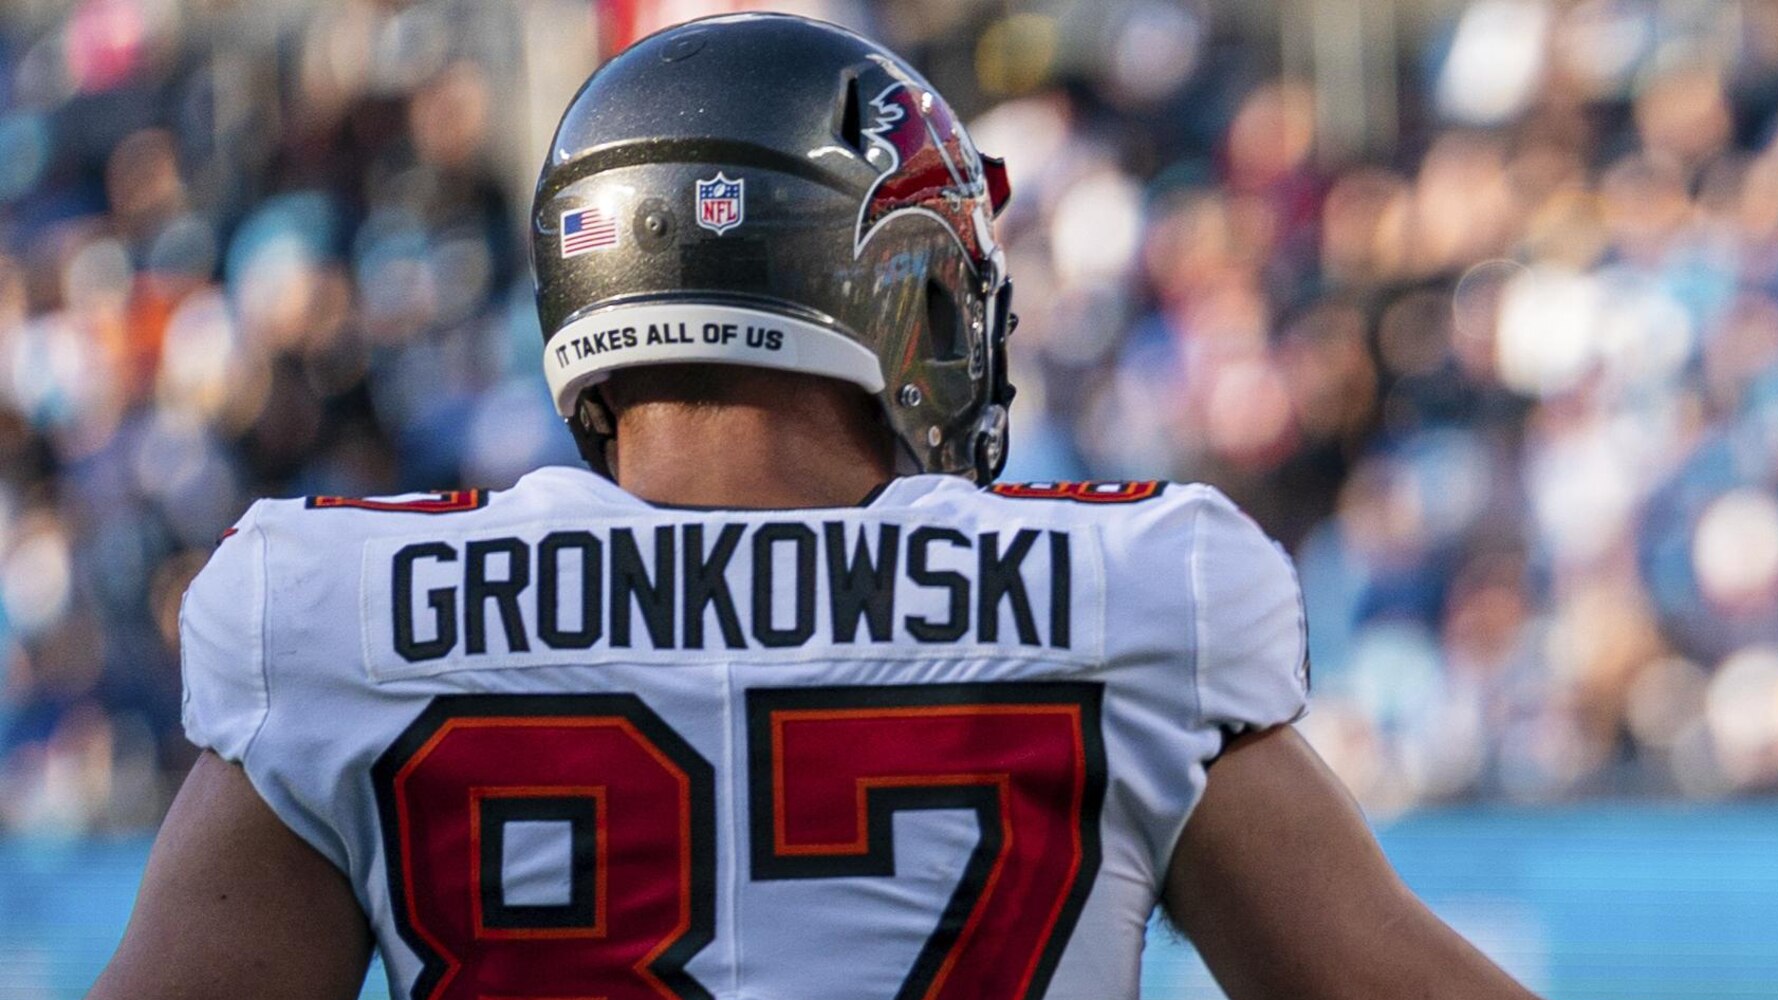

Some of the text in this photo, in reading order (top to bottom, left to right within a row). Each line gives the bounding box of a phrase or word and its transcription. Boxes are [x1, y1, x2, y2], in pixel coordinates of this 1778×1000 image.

[703, 200, 737, 224] NFL
[555, 322, 784, 369] IT TAKES ALL OF US
[391, 520, 1071, 662] GRONKOWSKI
